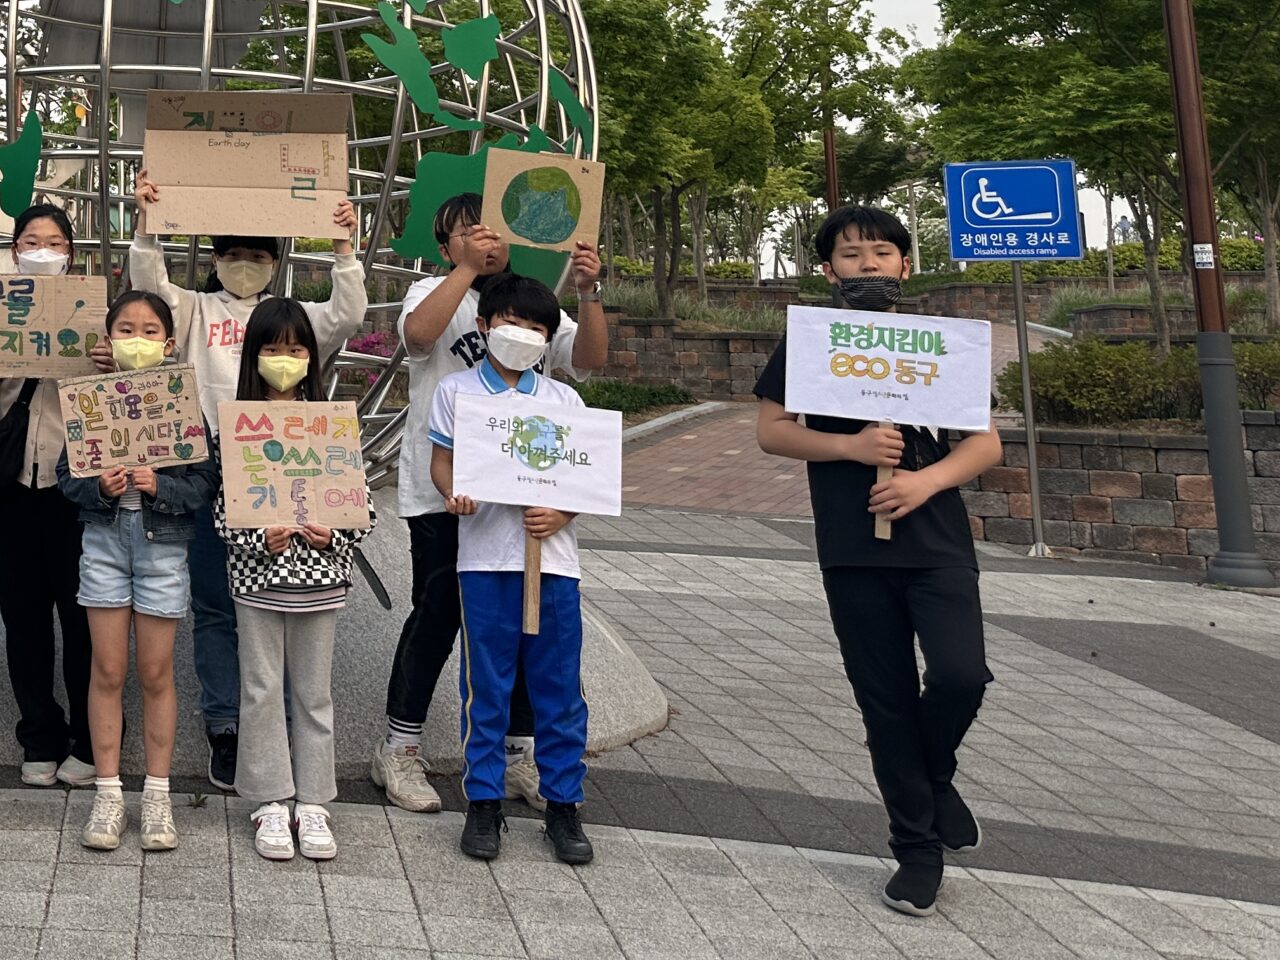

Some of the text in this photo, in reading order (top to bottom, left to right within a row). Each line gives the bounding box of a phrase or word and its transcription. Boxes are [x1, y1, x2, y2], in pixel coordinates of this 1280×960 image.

[208, 139, 250, 150] Earth day
[960, 231, 1071, 246] 장애인용 경사로
[973, 247, 1007, 255] Disabled
[1036, 248, 1058, 256] ramp
[830, 352, 940, 386] eco 동구
[78, 390, 164, 431] 일회용을
[234, 412, 360, 441] 쓰레기
[486, 417, 523, 436] 우리의
[501, 441, 592, 467] 더 아껴주세요
